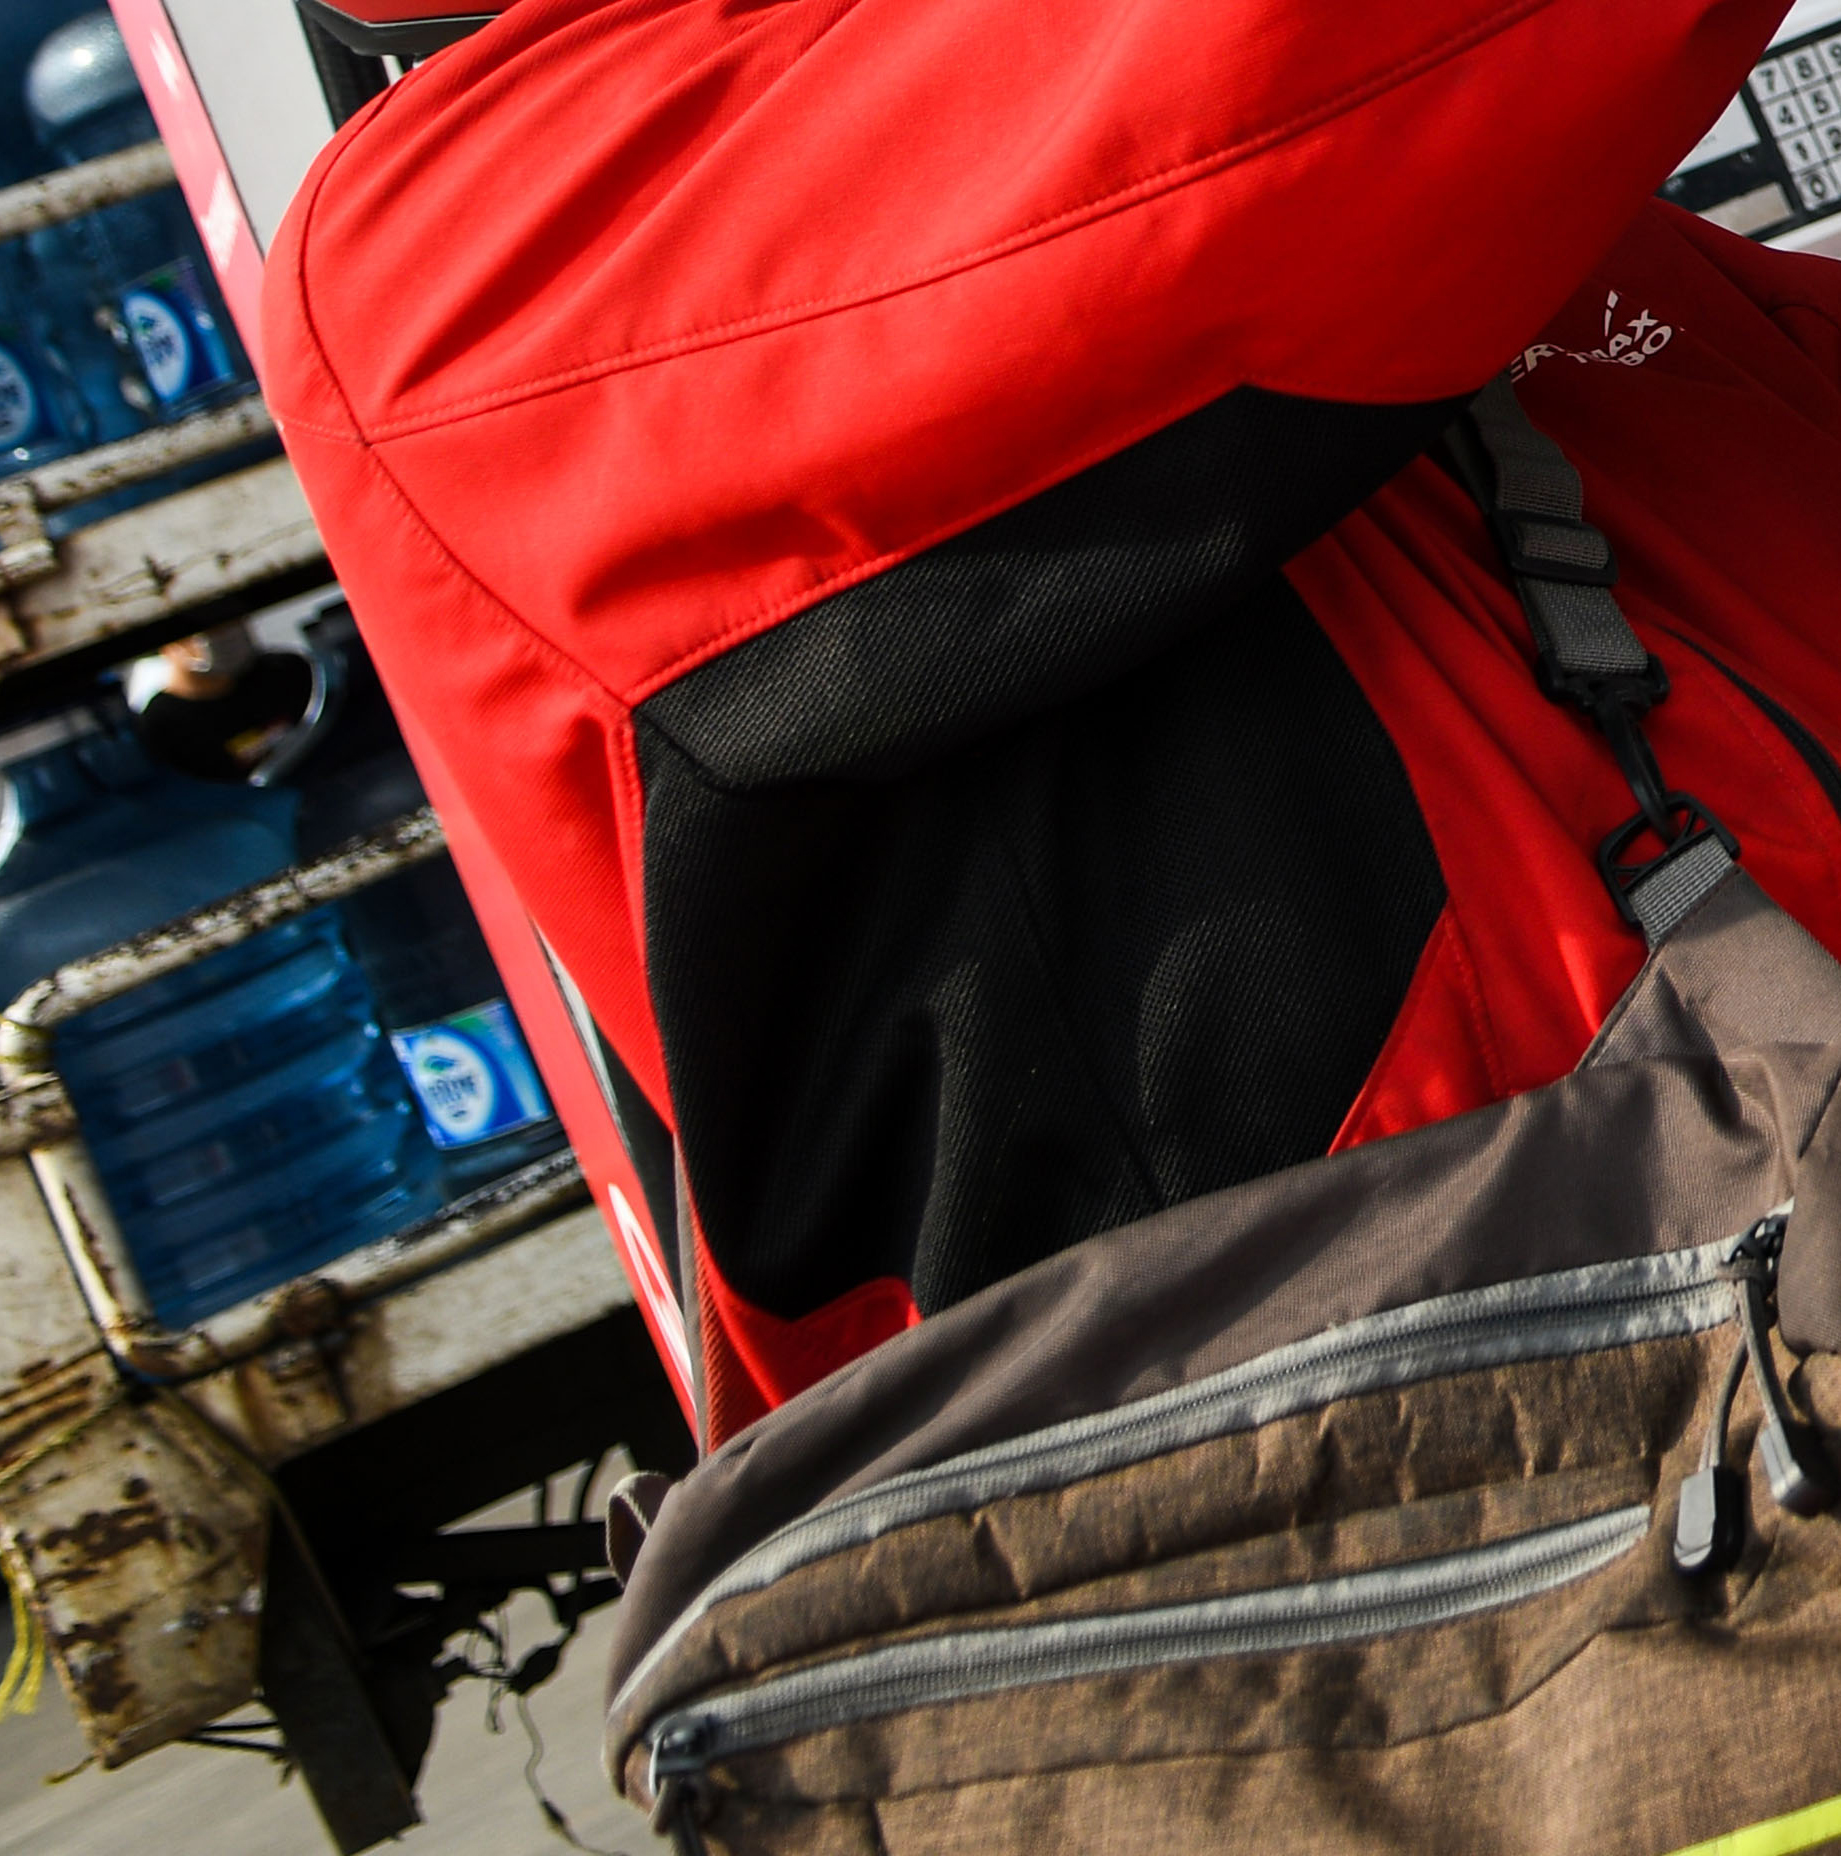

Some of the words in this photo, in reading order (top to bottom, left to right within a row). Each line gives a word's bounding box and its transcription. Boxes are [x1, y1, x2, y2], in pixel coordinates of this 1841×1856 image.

[1794, 56, 1814, 81] 8
[1777, 104, 1795, 126] 4
[1812, 93, 1830, 115] 5
[1806, 171, 1827, 195] 0
